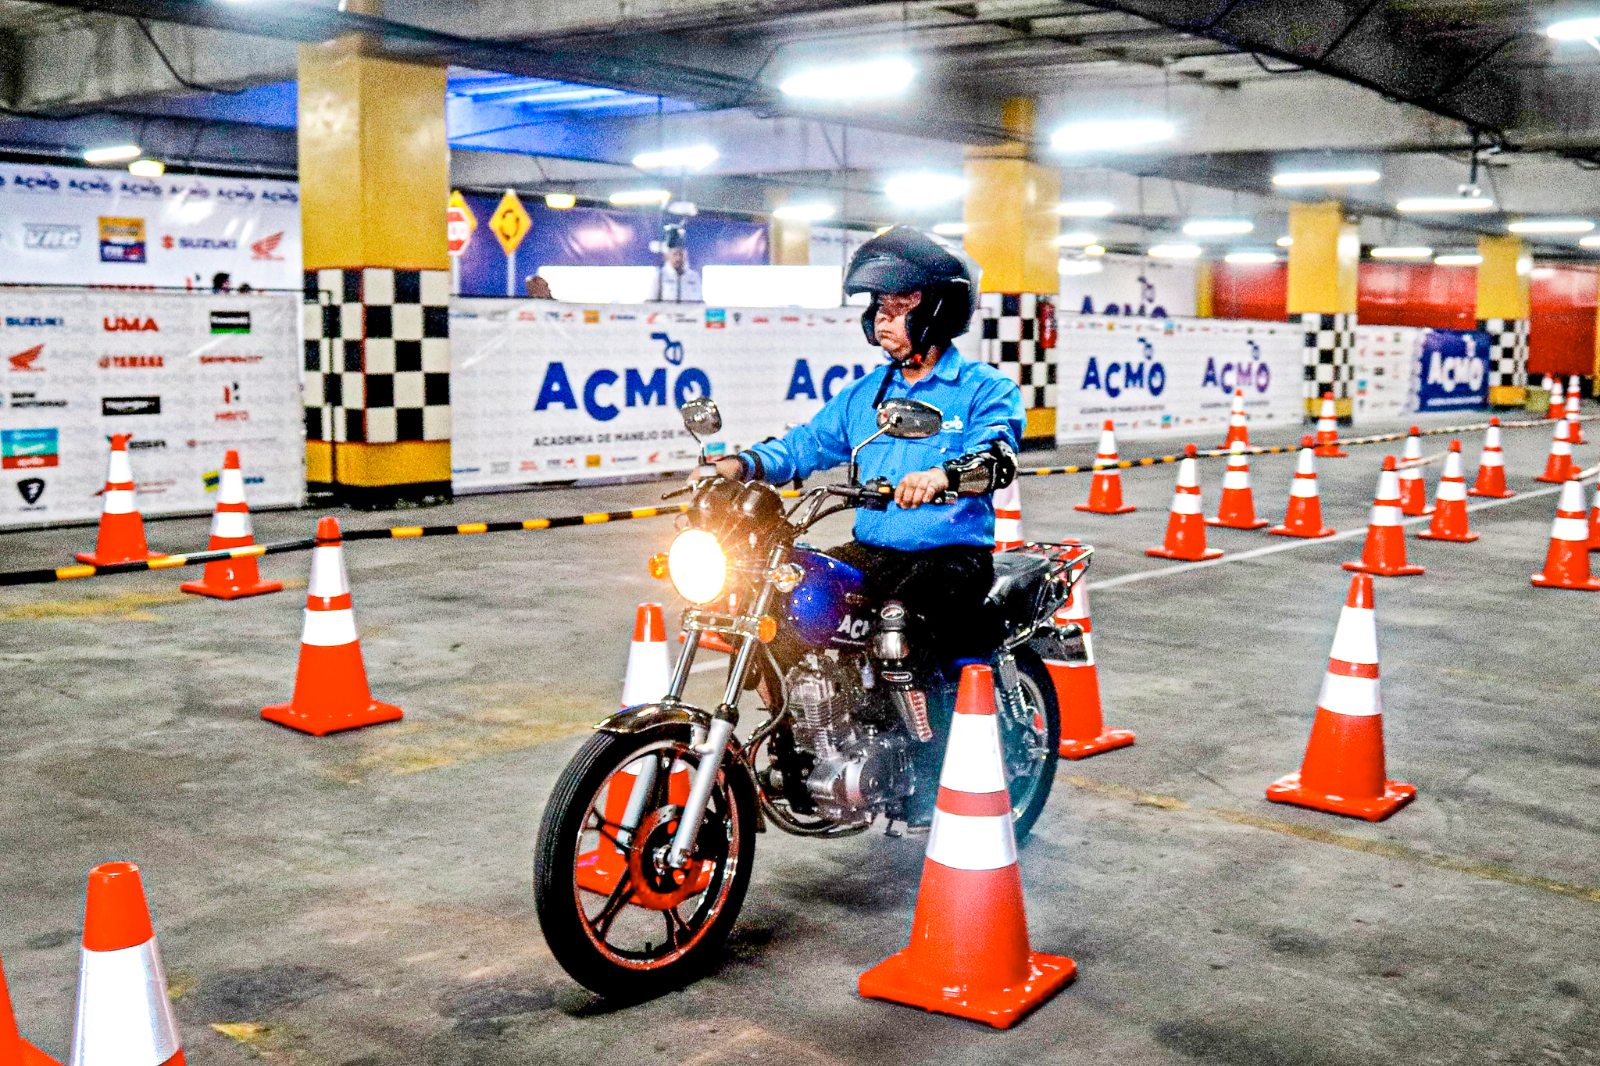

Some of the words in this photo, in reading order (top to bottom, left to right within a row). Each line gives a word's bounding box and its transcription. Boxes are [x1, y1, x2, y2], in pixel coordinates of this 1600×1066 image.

[179, 237, 236, 249] SUZUKI
[6, 317, 64, 327] SUZUKI
[103, 317, 159, 331] UMA
[1081, 356, 1166, 398] ACMO
[1202, 356, 1271, 394] ACMO
[534, 362, 711, 422] ACMO
[533, 435, 593, 447] ACADEMIA
[598, 433, 611, 443] DE
[615, 431, 658, 441] MANEJO
[662, 430, 674, 439] DE
